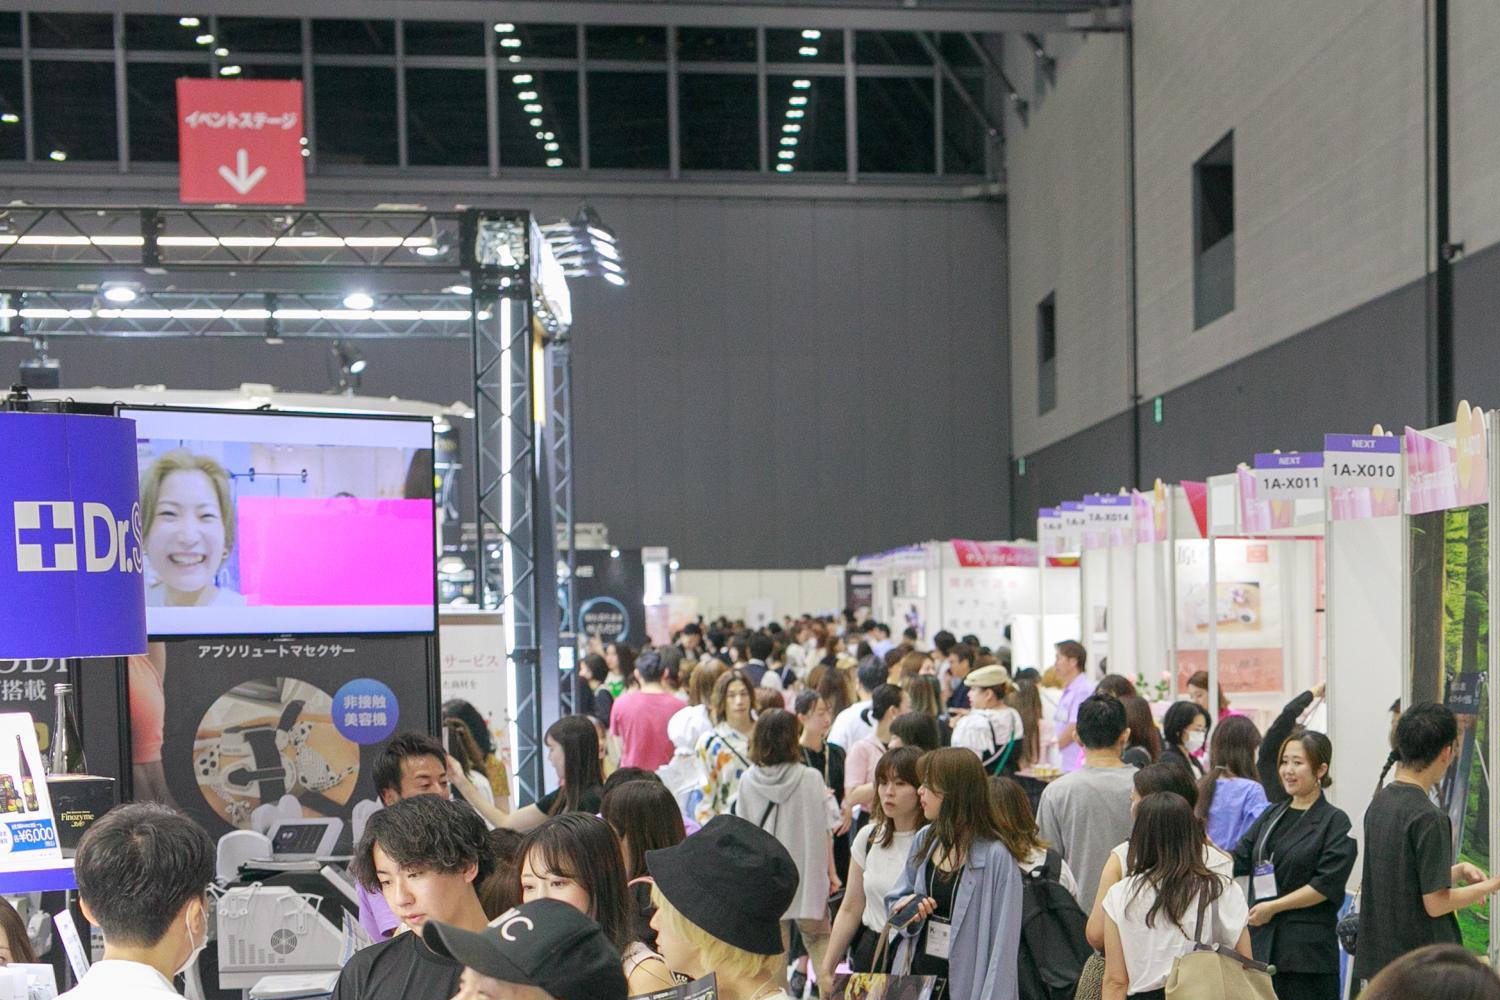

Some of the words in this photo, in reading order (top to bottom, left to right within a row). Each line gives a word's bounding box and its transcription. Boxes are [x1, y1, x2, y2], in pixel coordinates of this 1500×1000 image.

[185, 110, 298, 130] イベントステージ
[1352, 439, 1376, 448] NEXT
[1278, 457, 1300, 465] NEXT
[1332, 463, 1395, 477] 1A-X010
[1264, 477, 1319, 489] 1A-X011
[198, 644, 356, 658] アブソリュートマセクサー
[343, 695, 387, 710] 非接触
